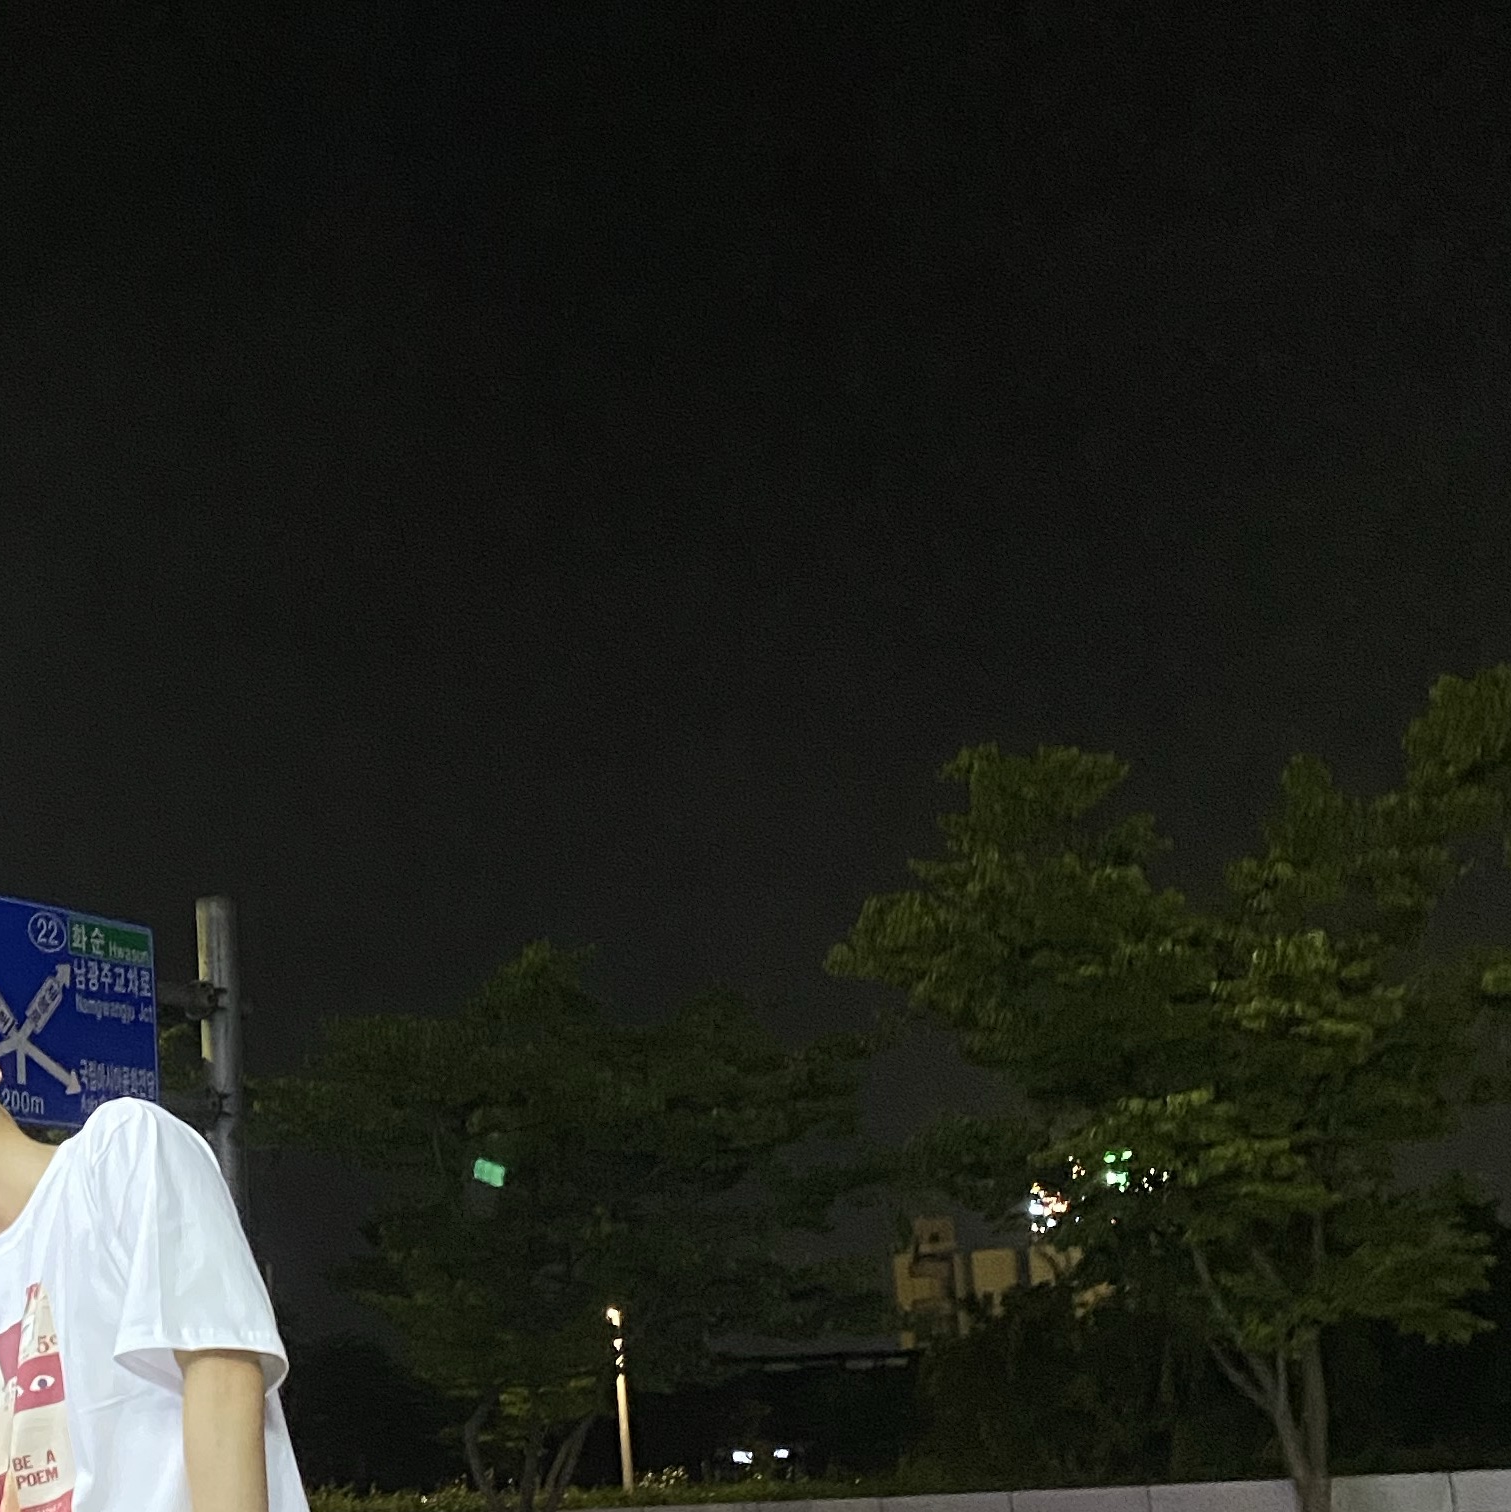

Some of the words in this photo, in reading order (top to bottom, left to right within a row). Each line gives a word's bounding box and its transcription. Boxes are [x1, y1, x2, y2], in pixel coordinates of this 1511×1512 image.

[35, 920, 60, 944] 22
[71, 923, 108, 954] 화순
[1, 1087, 45, 1115] 200m
[12, 1453, 33, 1472] BE
[45, 1448, 57, 1466] A
[16, 1466, 60, 1490] POEM
